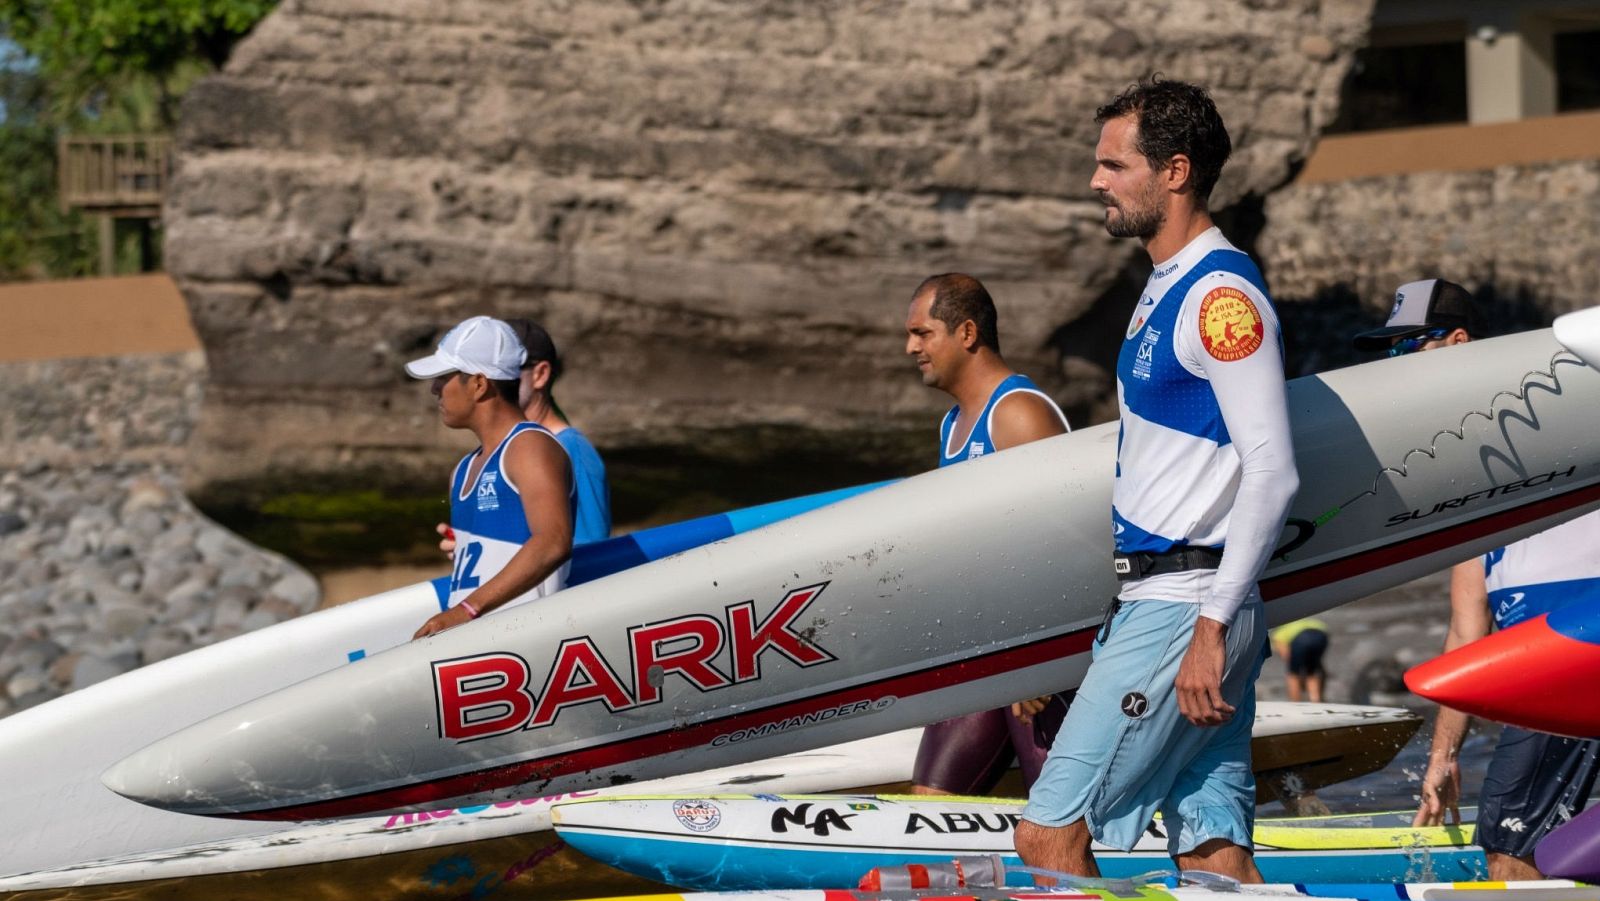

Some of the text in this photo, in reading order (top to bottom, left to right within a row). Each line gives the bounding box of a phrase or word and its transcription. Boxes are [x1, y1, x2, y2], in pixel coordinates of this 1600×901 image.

[1136, 341, 1153, 362] ISA
[477, 483, 497, 497] ISA
[1384, 465, 1577, 528] SURFTECH
[431, 580, 838, 744] BARK
[711, 700, 871, 747] COMMANDER
